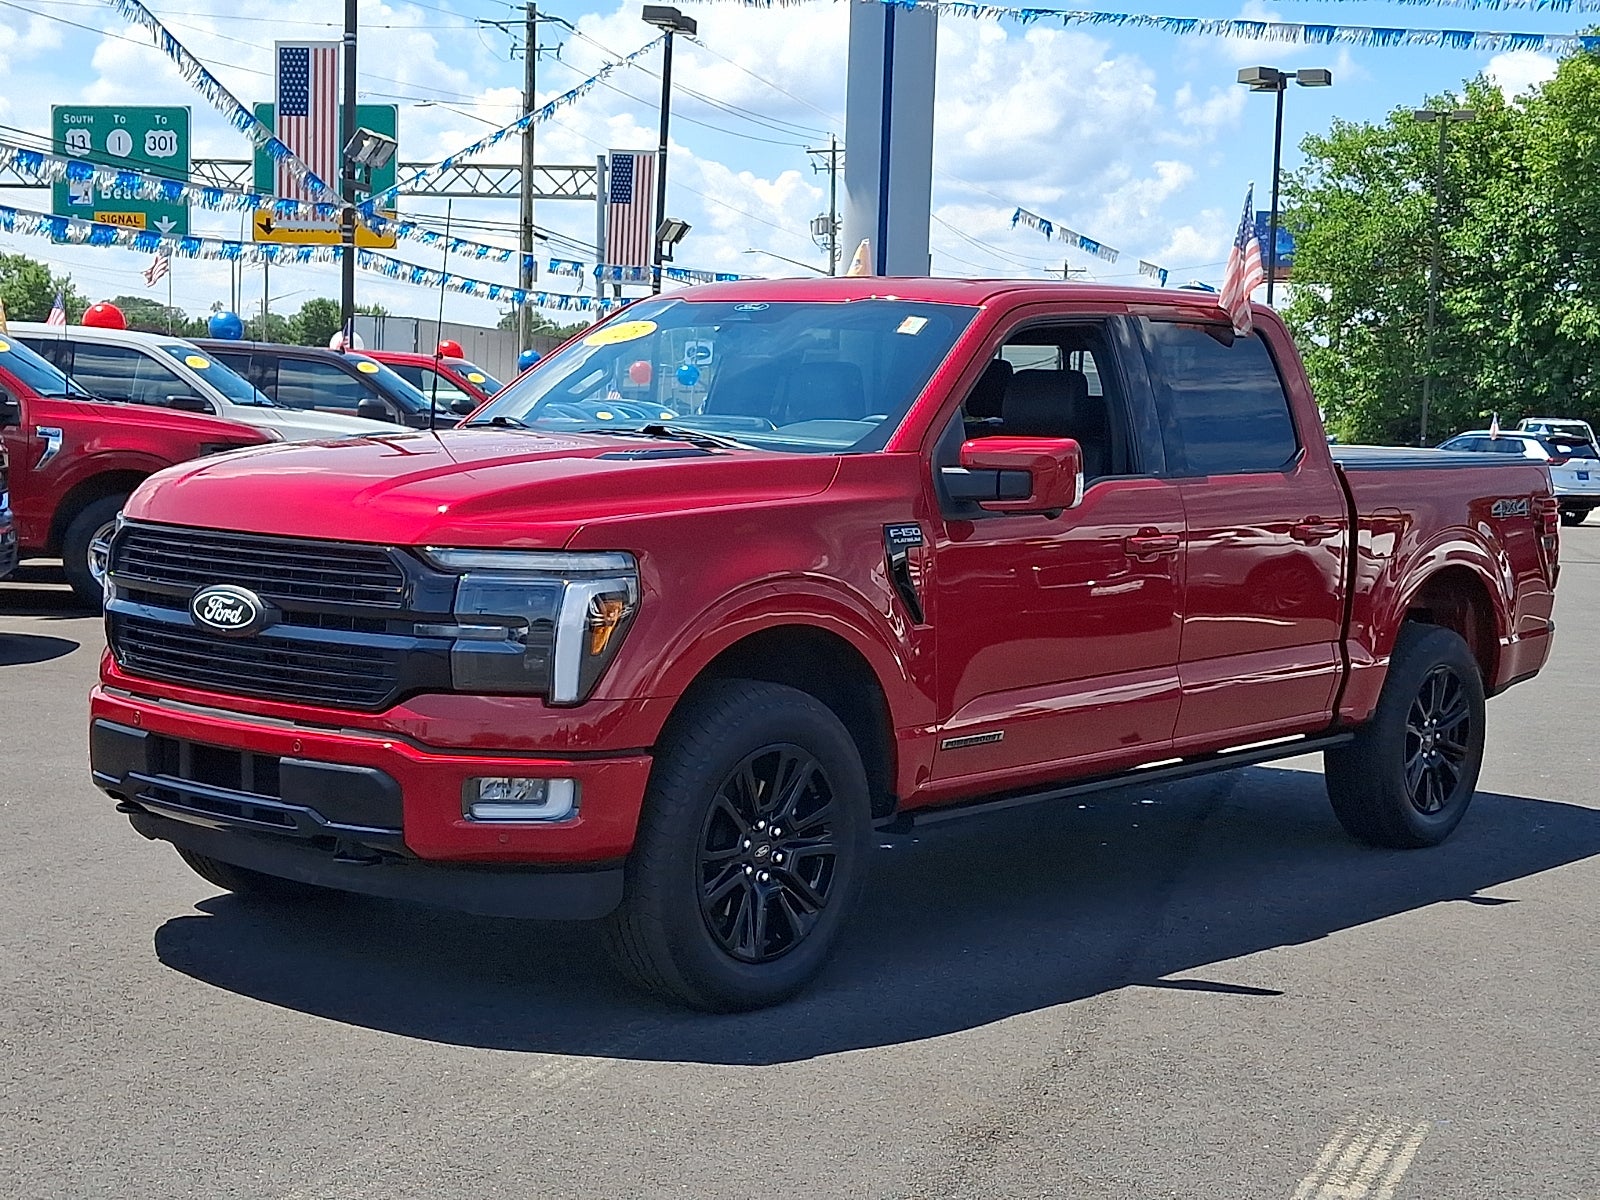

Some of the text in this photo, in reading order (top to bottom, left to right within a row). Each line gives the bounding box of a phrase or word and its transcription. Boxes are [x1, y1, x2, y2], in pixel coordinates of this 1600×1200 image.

[63, 113, 94, 124] SOUTH
[71, 134, 86, 150] 13
[117, 136, 121, 151] 1
[147, 135, 173, 152] 301
[100, 214, 141, 224] SIGNAL
[890, 527, 922, 538] F-150
[893, 536, 921, 544] PLATINUM
[204, 595, 244, 624] Ford
